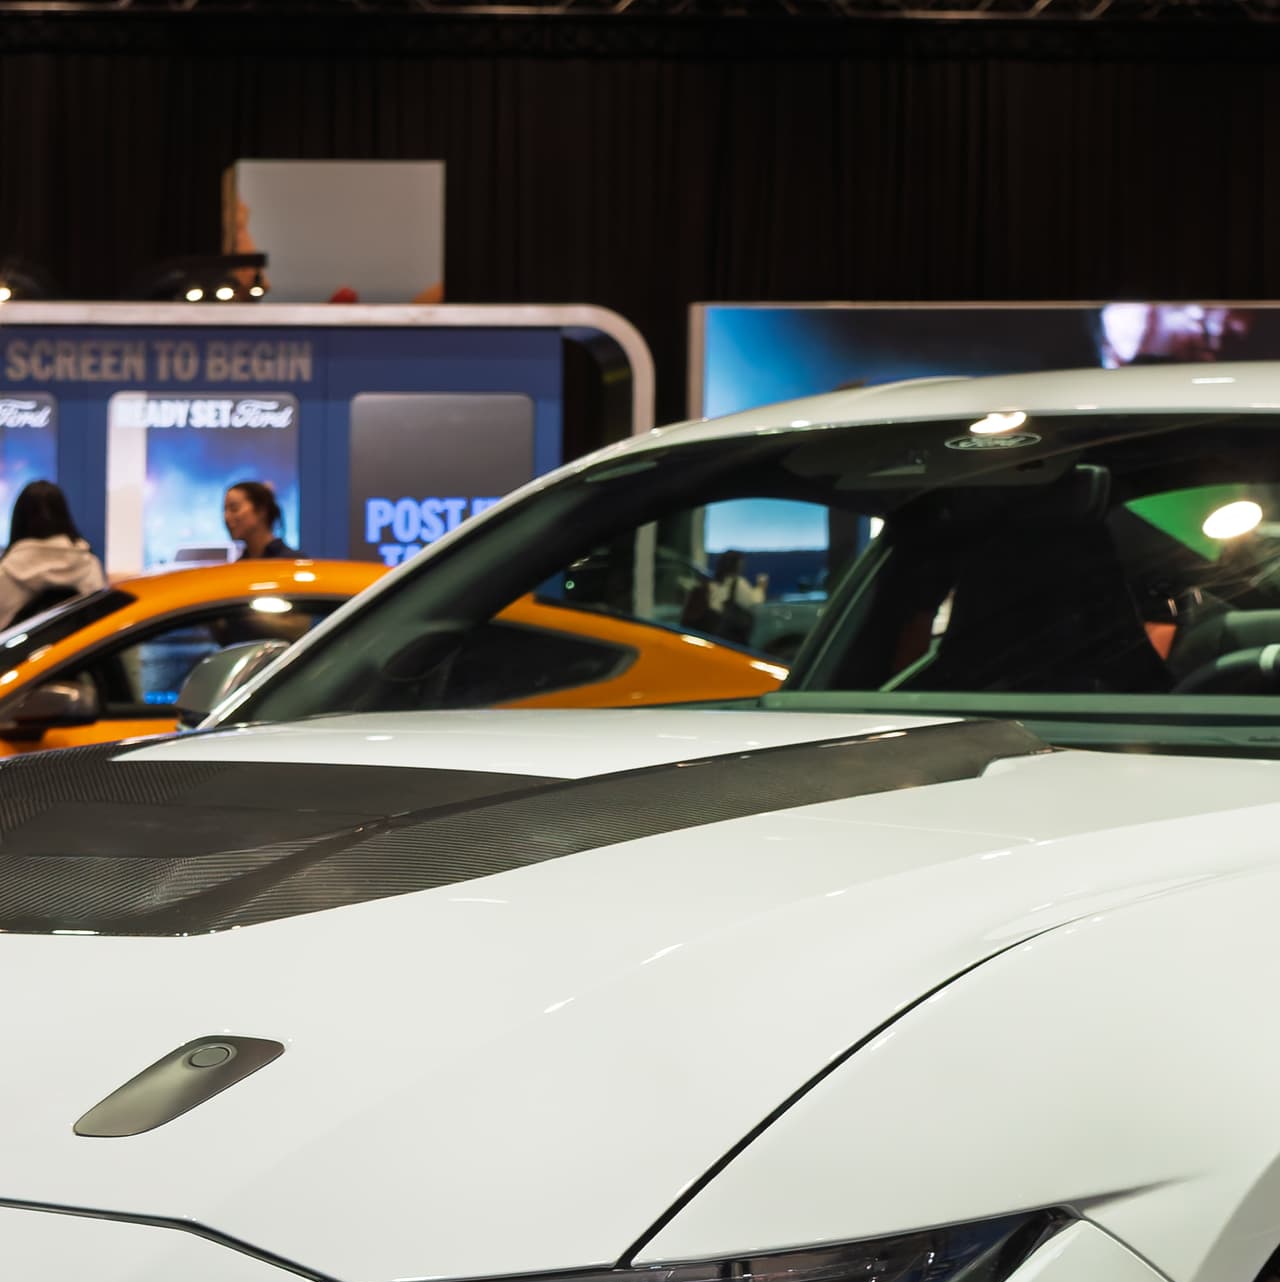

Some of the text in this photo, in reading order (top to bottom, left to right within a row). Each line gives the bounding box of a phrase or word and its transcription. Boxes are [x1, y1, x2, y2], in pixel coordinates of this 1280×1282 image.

[6, 340, 145, 381] SCREEN
[155, 340, 198, 382] TO
[206, 341, 312, 382] BEGIN
[189, 399, 232, 428] SET
[231, 399, 293, 428] Ford
[365, 497, 467, 543] POST
